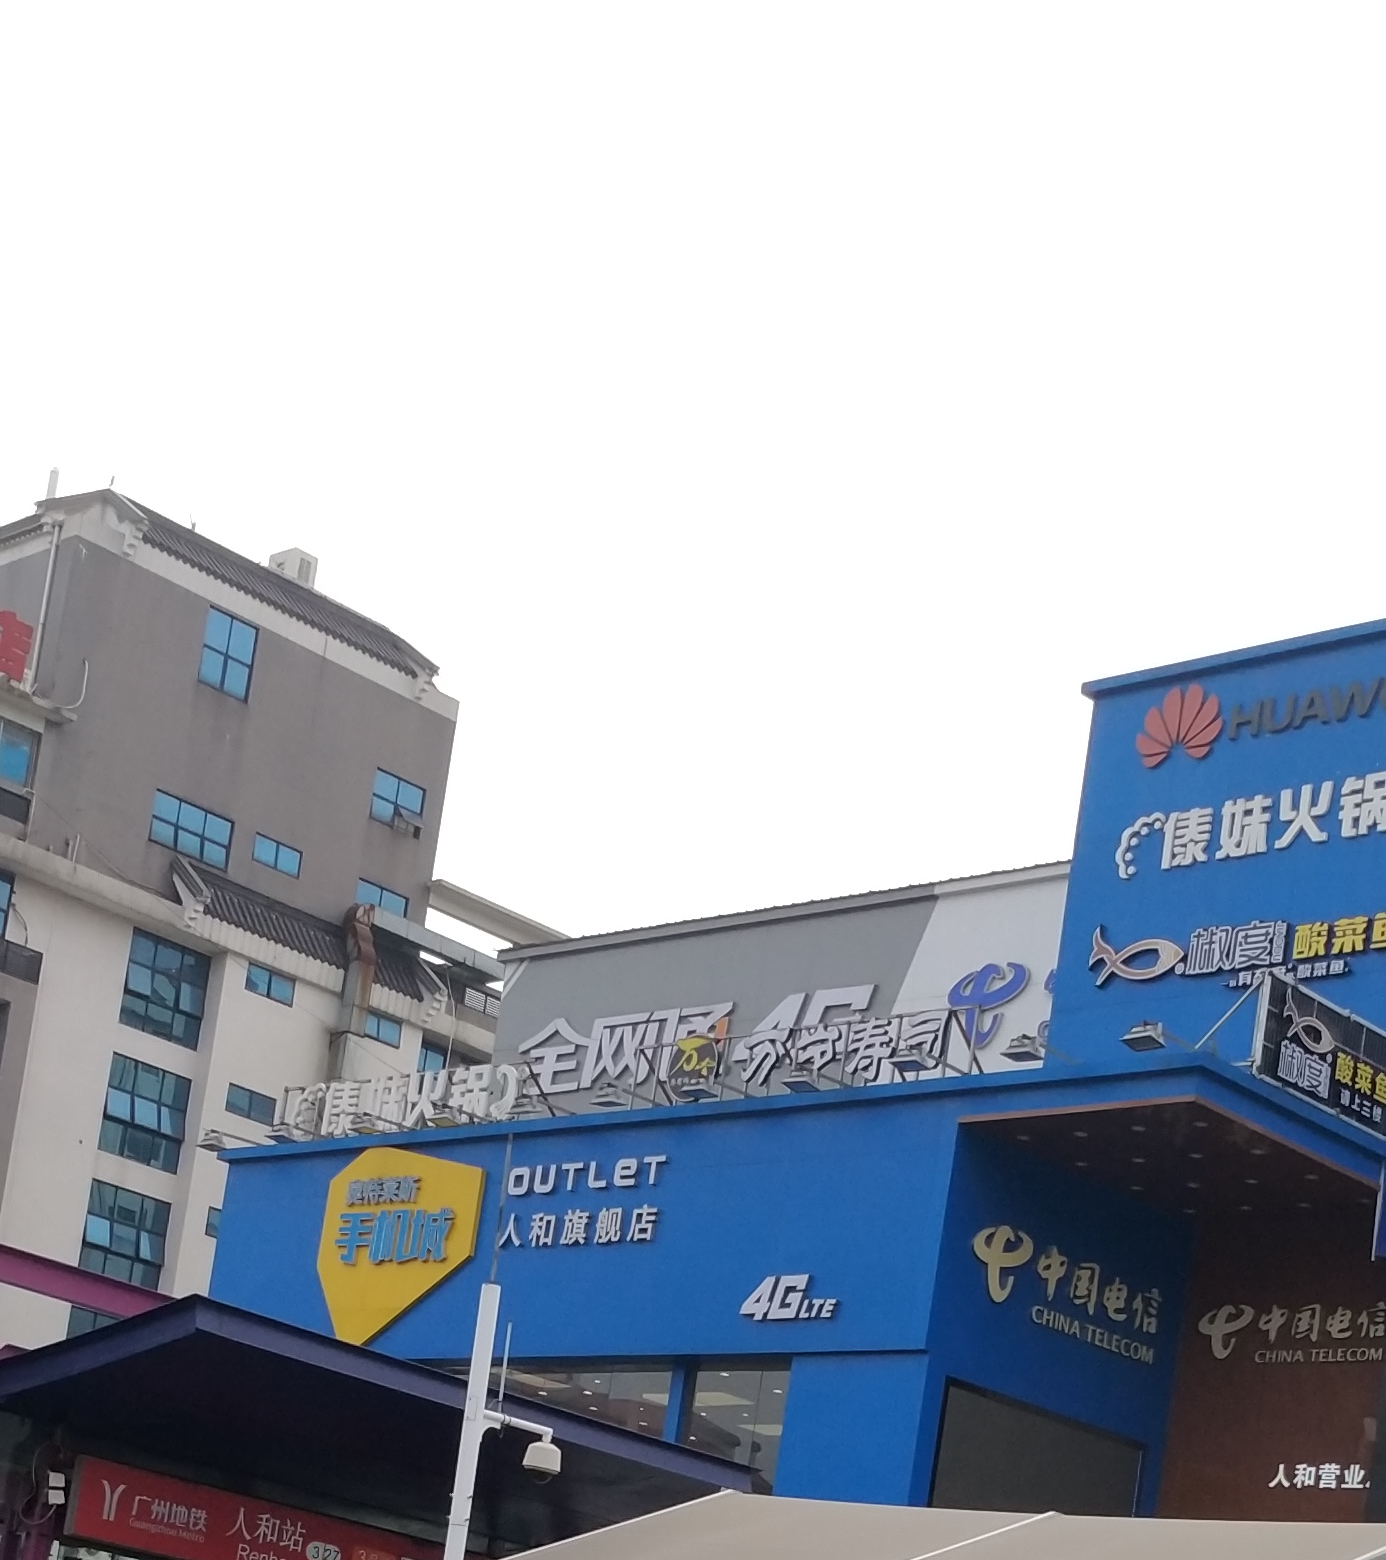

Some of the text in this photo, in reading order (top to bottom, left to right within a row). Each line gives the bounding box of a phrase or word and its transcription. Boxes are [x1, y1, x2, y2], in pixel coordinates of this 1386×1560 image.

[334, 1208, 455, 1267] 手机城
[498, 1203, 659, 1250] 人和旗舰店
[1035, 1245, 1162, 1335] 中国电信
[1030, 1304, 1155, 1366] CHINA TELECOM
[1253, 1346, 1384, 1363] CHINA TELECOM
[1267, 1463, 1372, 1491] 人和营业
[130, 1495, 208, 1533] 广州地铁
[225, 1506, 307, 1553] 人和站
